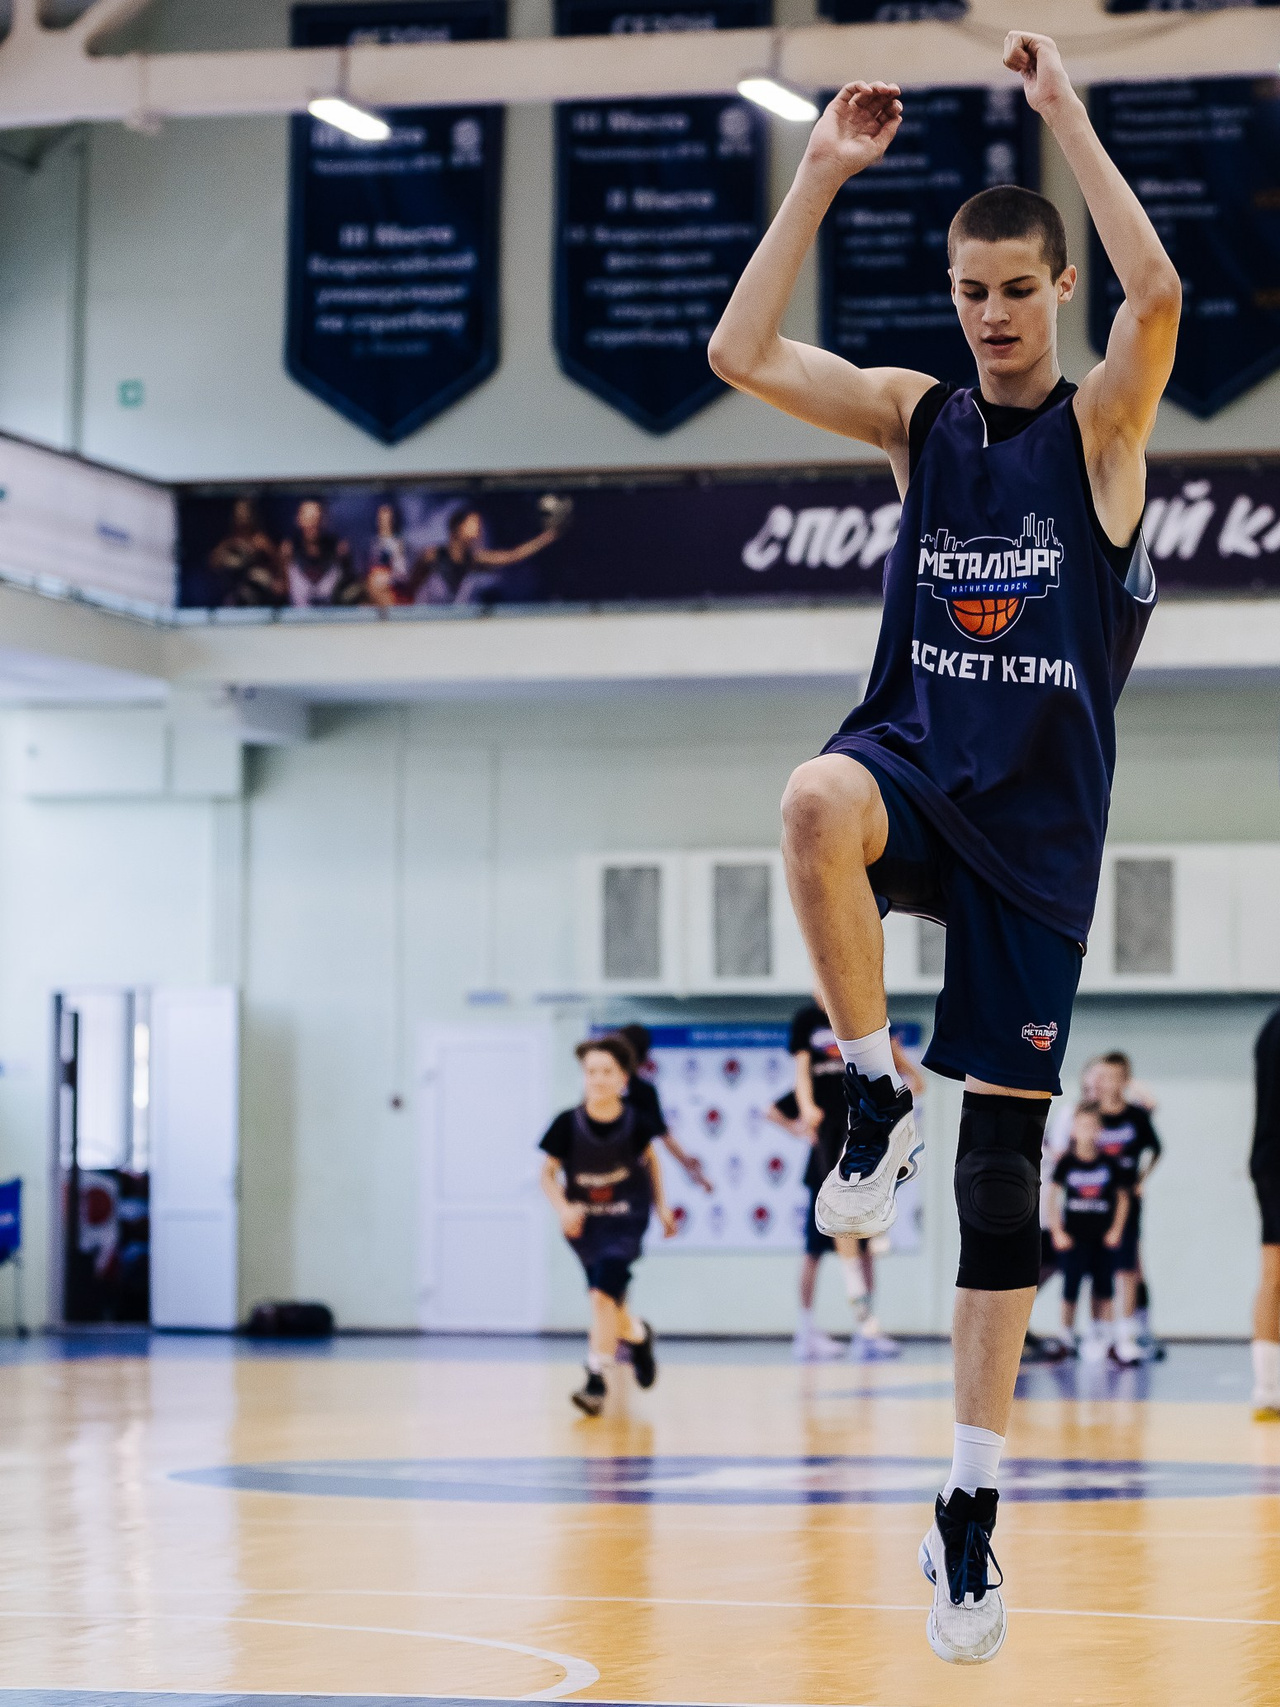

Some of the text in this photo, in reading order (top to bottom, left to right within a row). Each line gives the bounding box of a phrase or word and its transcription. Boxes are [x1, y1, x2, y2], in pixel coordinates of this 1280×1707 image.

[917, 547, 1061, 580] МЕТАЛЛУРГ
[951, 581, 1029, 593] МАГНИТОГОРСК
[911, 639, 994, 681] АСКЕТ
